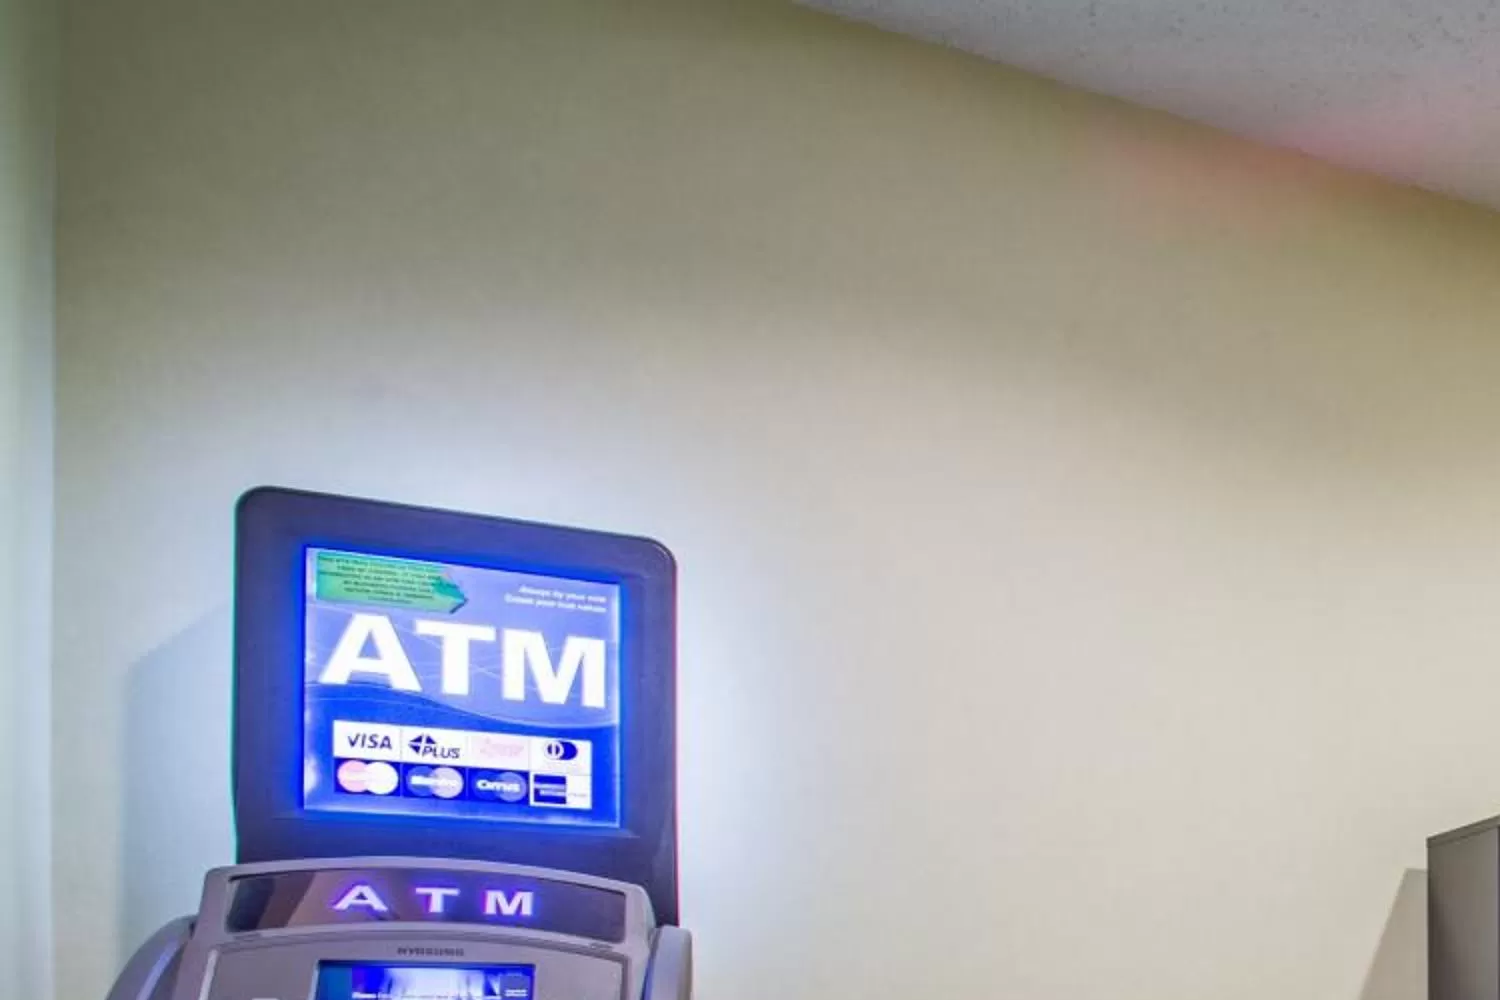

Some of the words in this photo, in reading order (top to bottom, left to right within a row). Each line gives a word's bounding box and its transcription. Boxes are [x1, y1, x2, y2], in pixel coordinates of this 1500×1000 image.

[317, 612, 606, 708] ATM
[347, 733, 393, 750] VISA
[422, 744, 461, 760] PLUS
[333, 884, 534, 916] ATM
